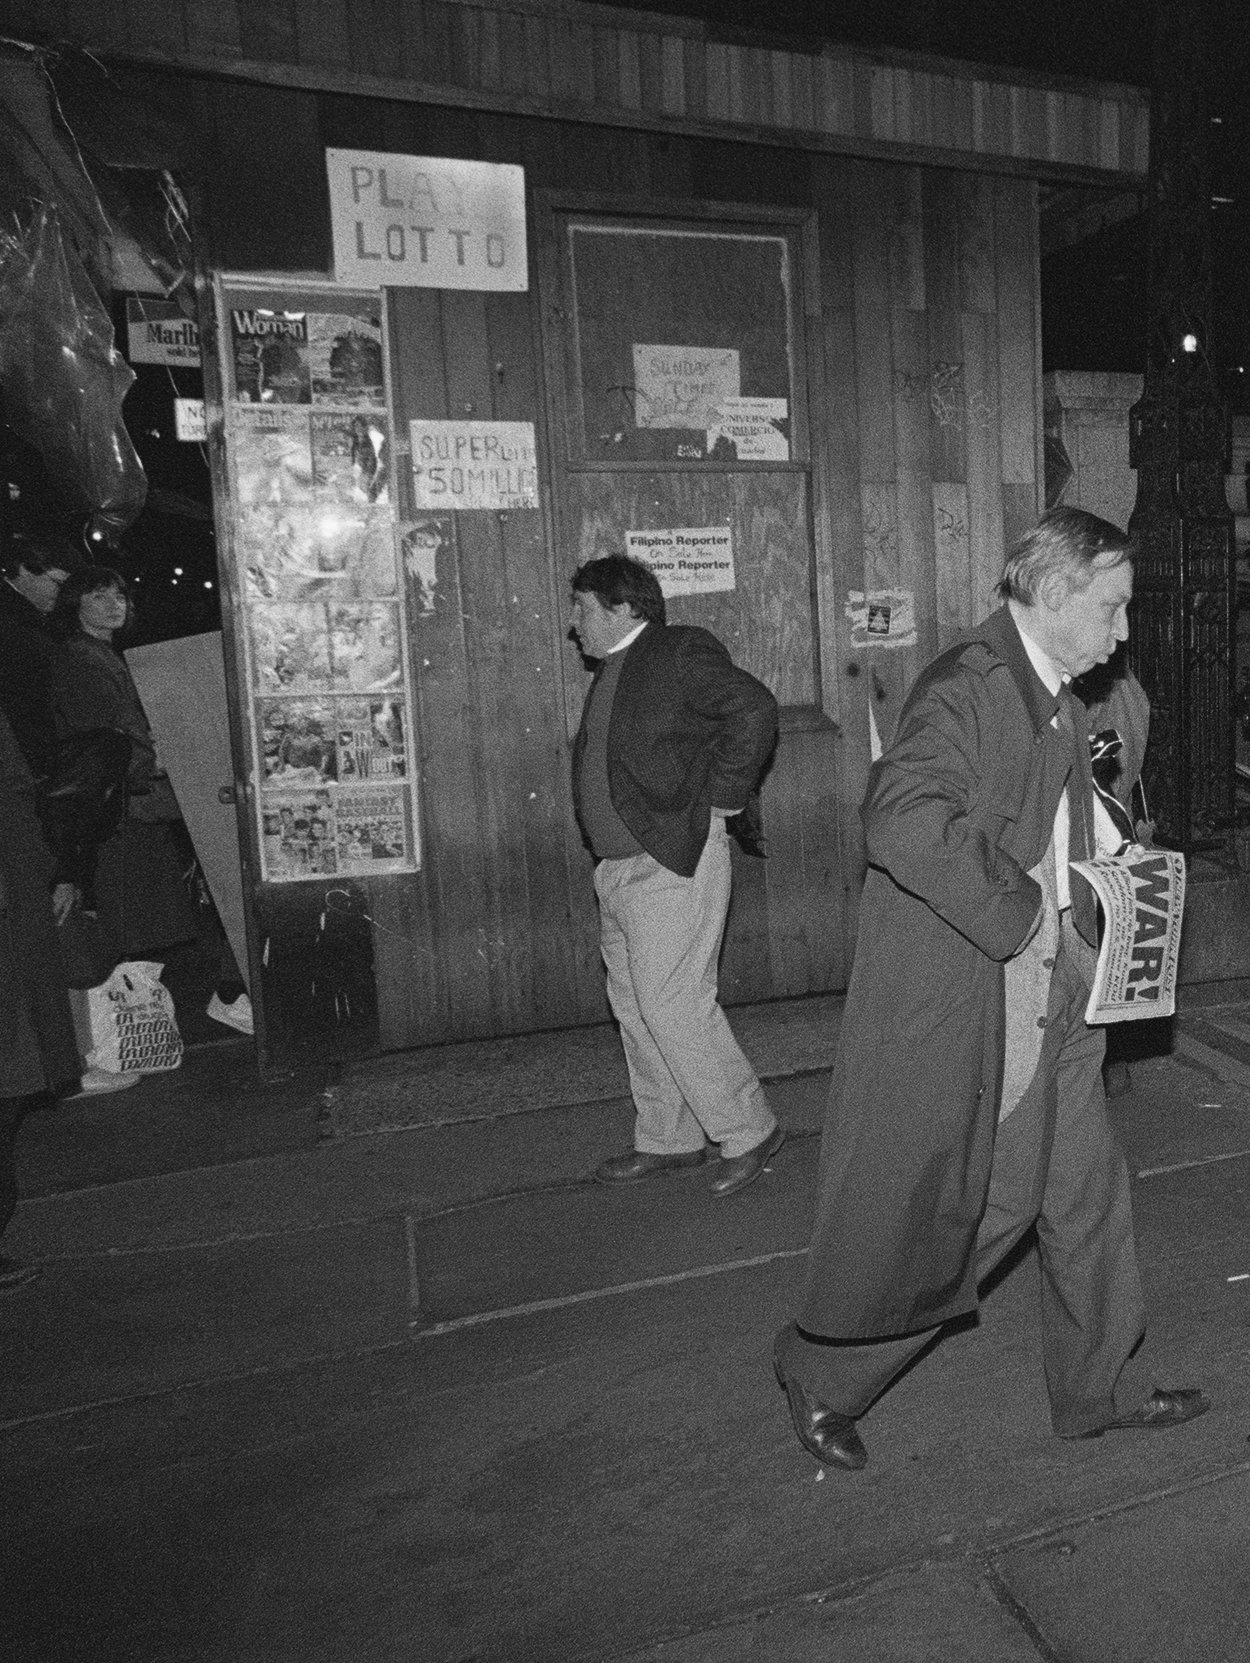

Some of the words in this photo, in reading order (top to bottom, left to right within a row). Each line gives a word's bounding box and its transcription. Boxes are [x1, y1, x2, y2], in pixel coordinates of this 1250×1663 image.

[355, 221, 505, 268] LOTTO
[233, 309, 304, 338] Woman
[421, 435, 500, 460] SUPER
[630, 536, 673, 547] Filipino
[675, 534, 729, 547] Reporter
[678, 560, 731, 571] Reporter
[1126, 856, 1170, 1001] WAR!
